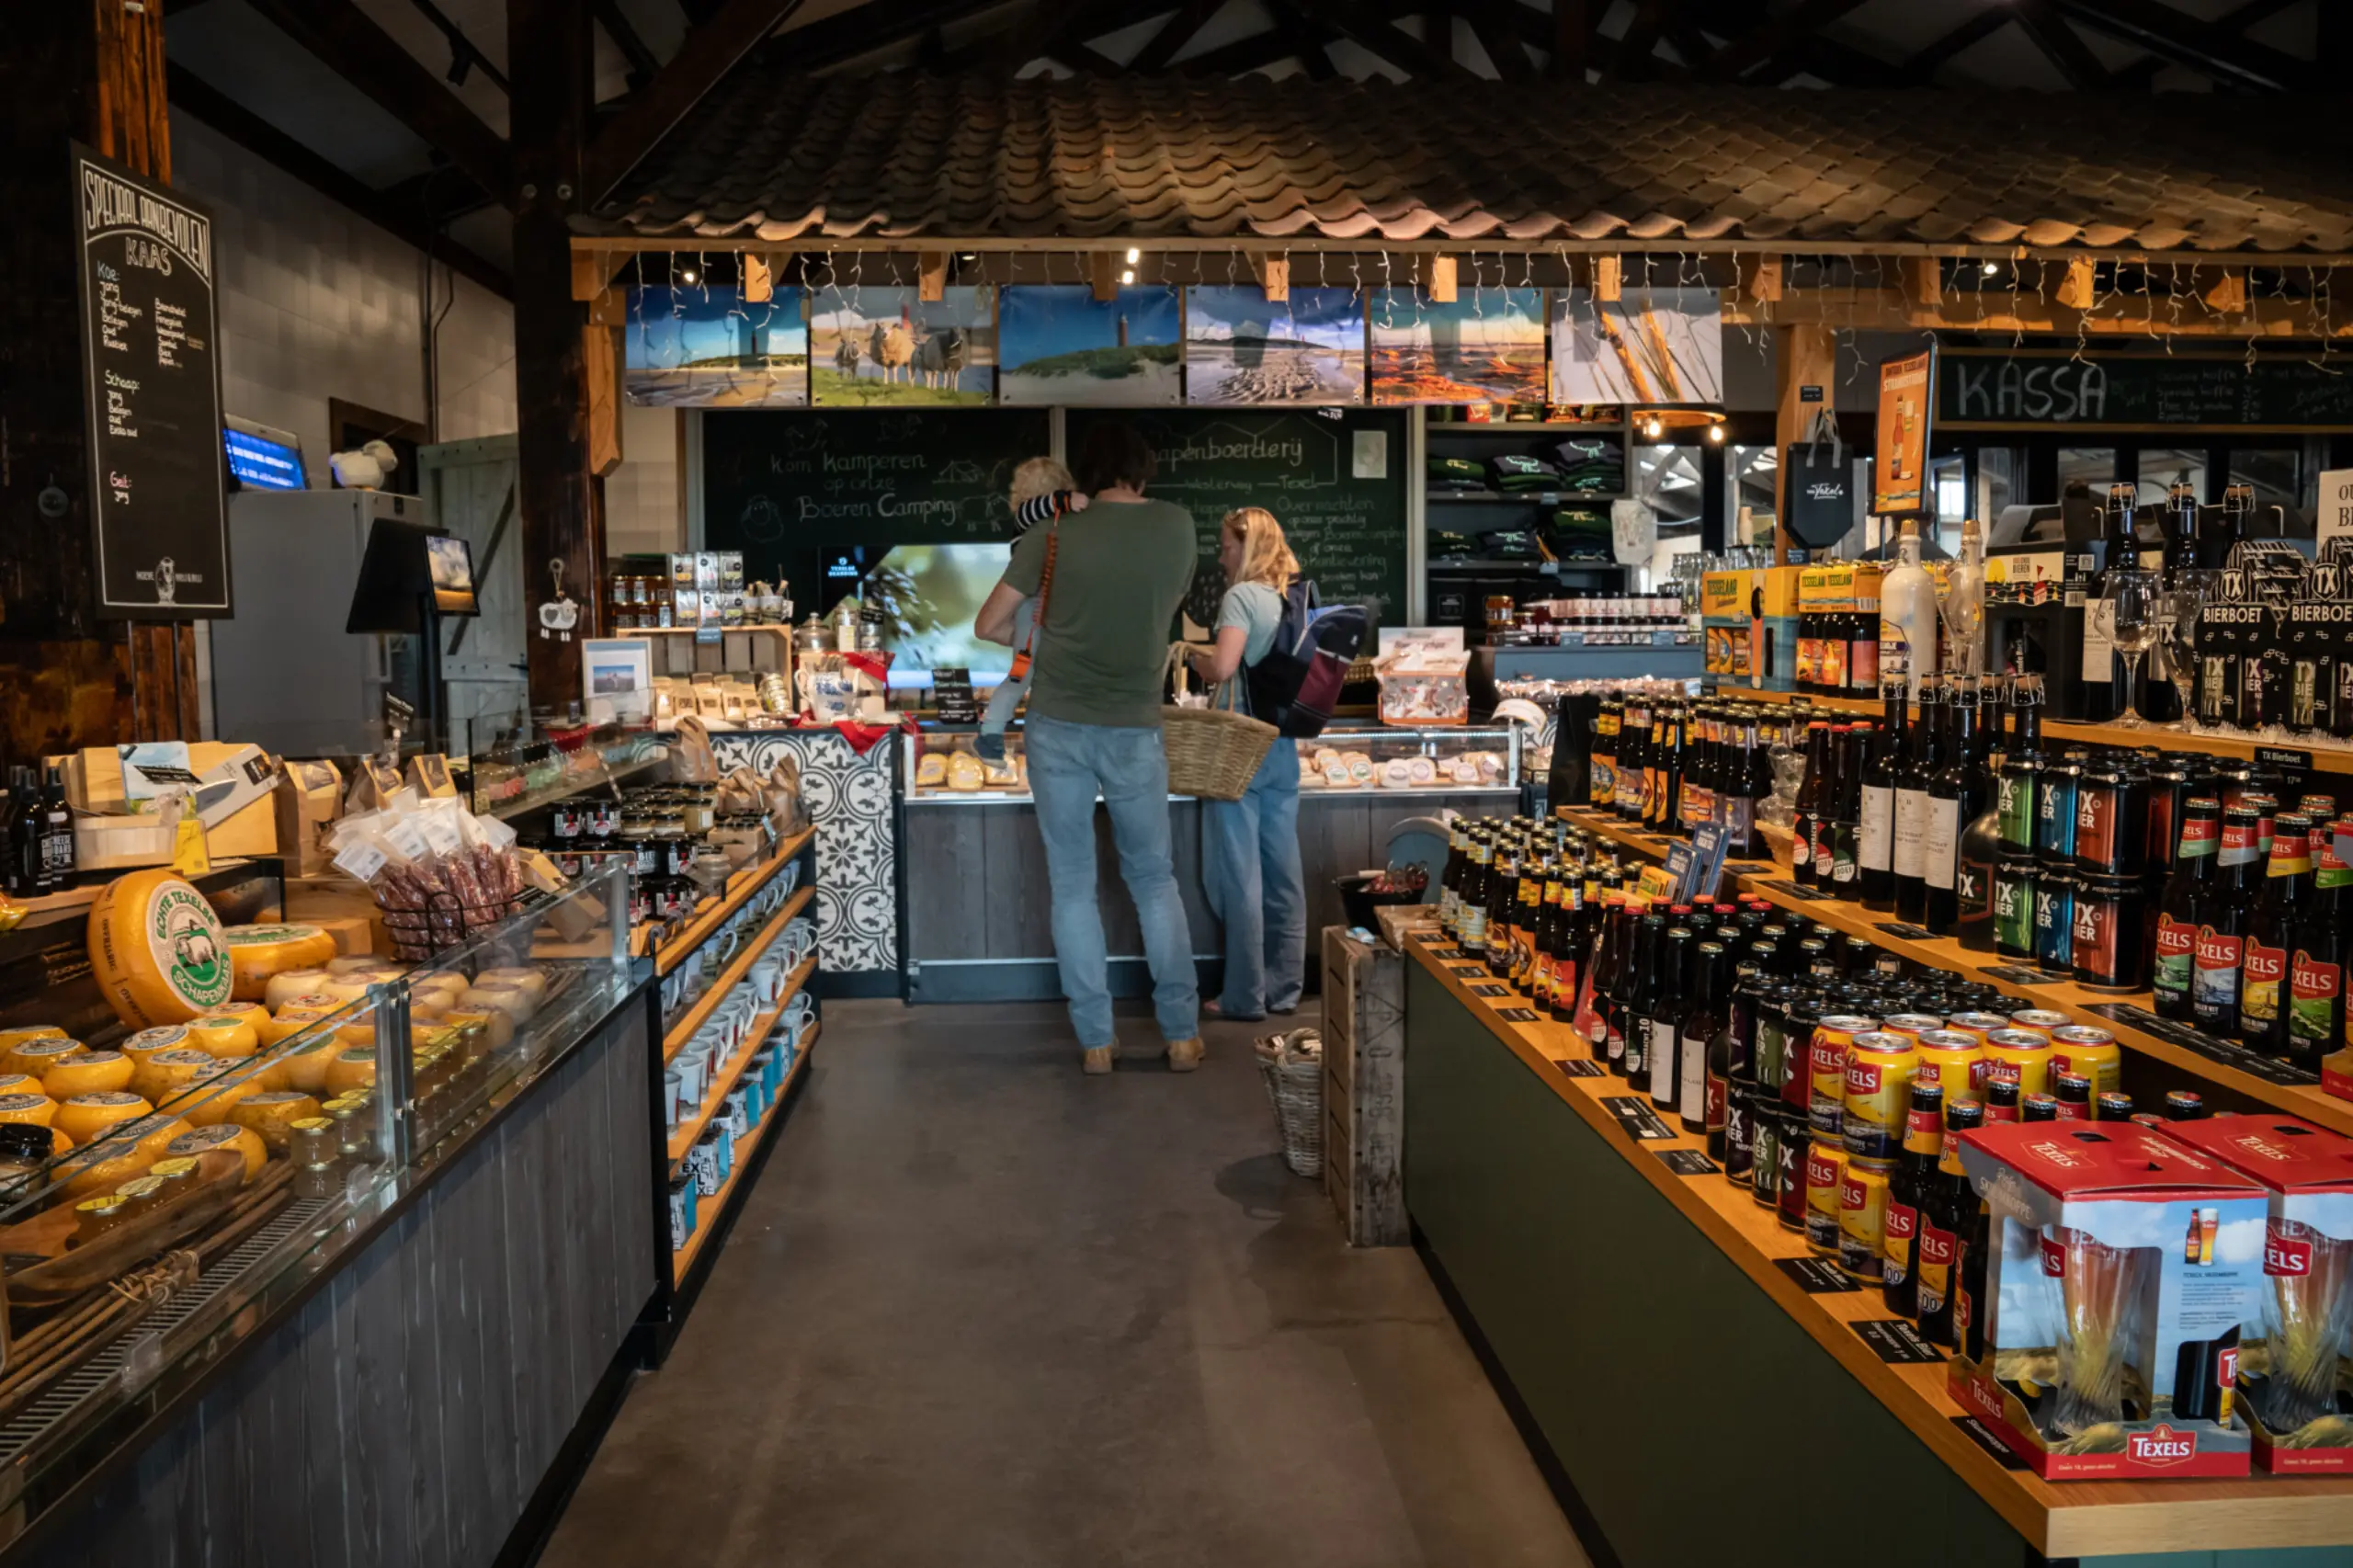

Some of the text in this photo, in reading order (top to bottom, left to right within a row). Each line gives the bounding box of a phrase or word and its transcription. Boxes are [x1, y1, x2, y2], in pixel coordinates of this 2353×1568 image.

[85, 169, 210, 278] SPECIAAL AANBEVOLEN
[125, 236, 173, 277] KAAS
[1957, 360, 2108, 422] KASSA
[770, 451, 812, 474] Kom
[797, 492, 958, 526] Boeren Camping
[2222, 572, 2244, 598] TX
[2314, 567, 2338, 596] TX
[2202, 607, 2263, 624] BIERBOET
[2291, 605, 2353, 622] BIERBOE
[2159, 622, 2177, 644] TX
[2031, 1141, 2080, 1168] TEXELS
[2235, 1135, 2291, 1161] TEXELS
[1971, 1379, 2003, 1419] TEXELS
[2132, 1437, 2190, 1457] TEXELS
